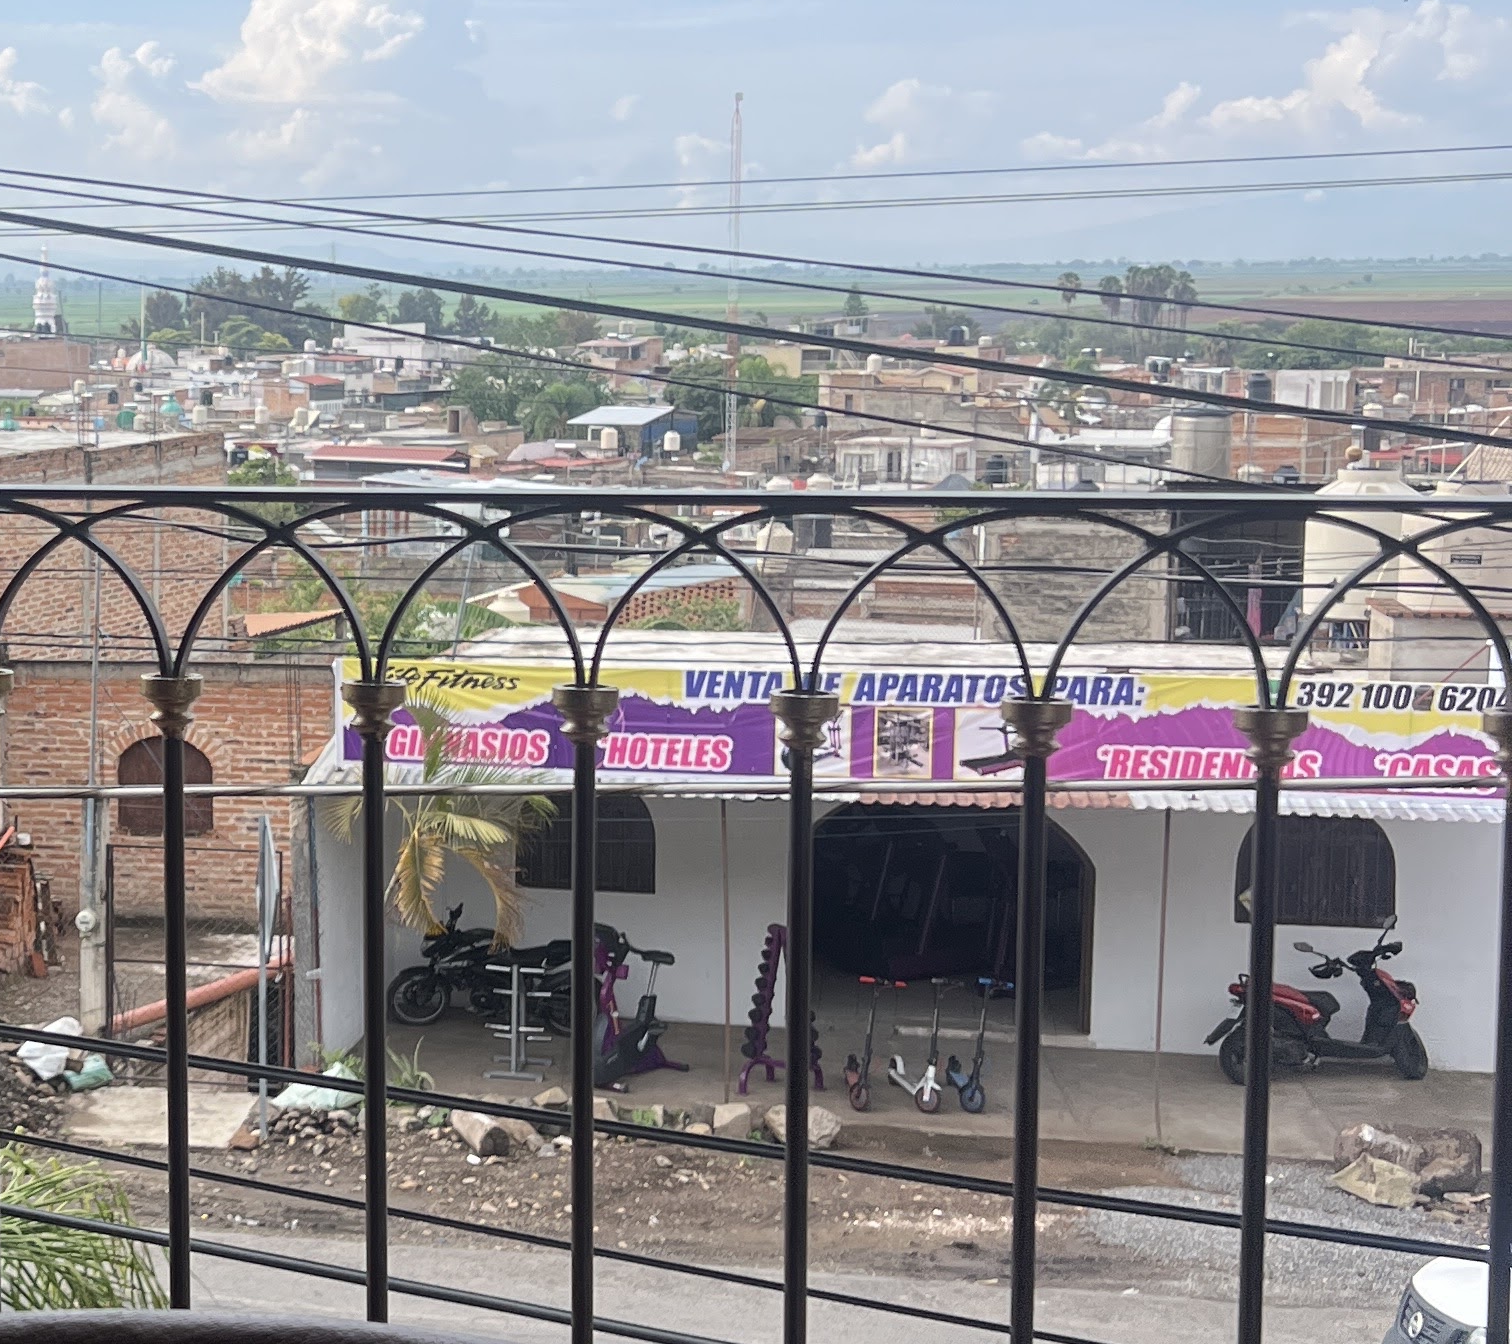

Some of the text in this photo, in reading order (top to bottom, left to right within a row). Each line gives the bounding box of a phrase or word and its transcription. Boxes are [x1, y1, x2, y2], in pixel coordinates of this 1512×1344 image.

[415, 669, 521, 693] Fitness
[685, 671, 783, 700] VENTA
[853, 673, 1028, 703] APARATOS
[1051, 676, 1145, 706] PARA:
[1296, 682, 1354, 708] 392
[1361, 684, 1413, 710] 100
[389, 728, 550, 766] GIASIOS
